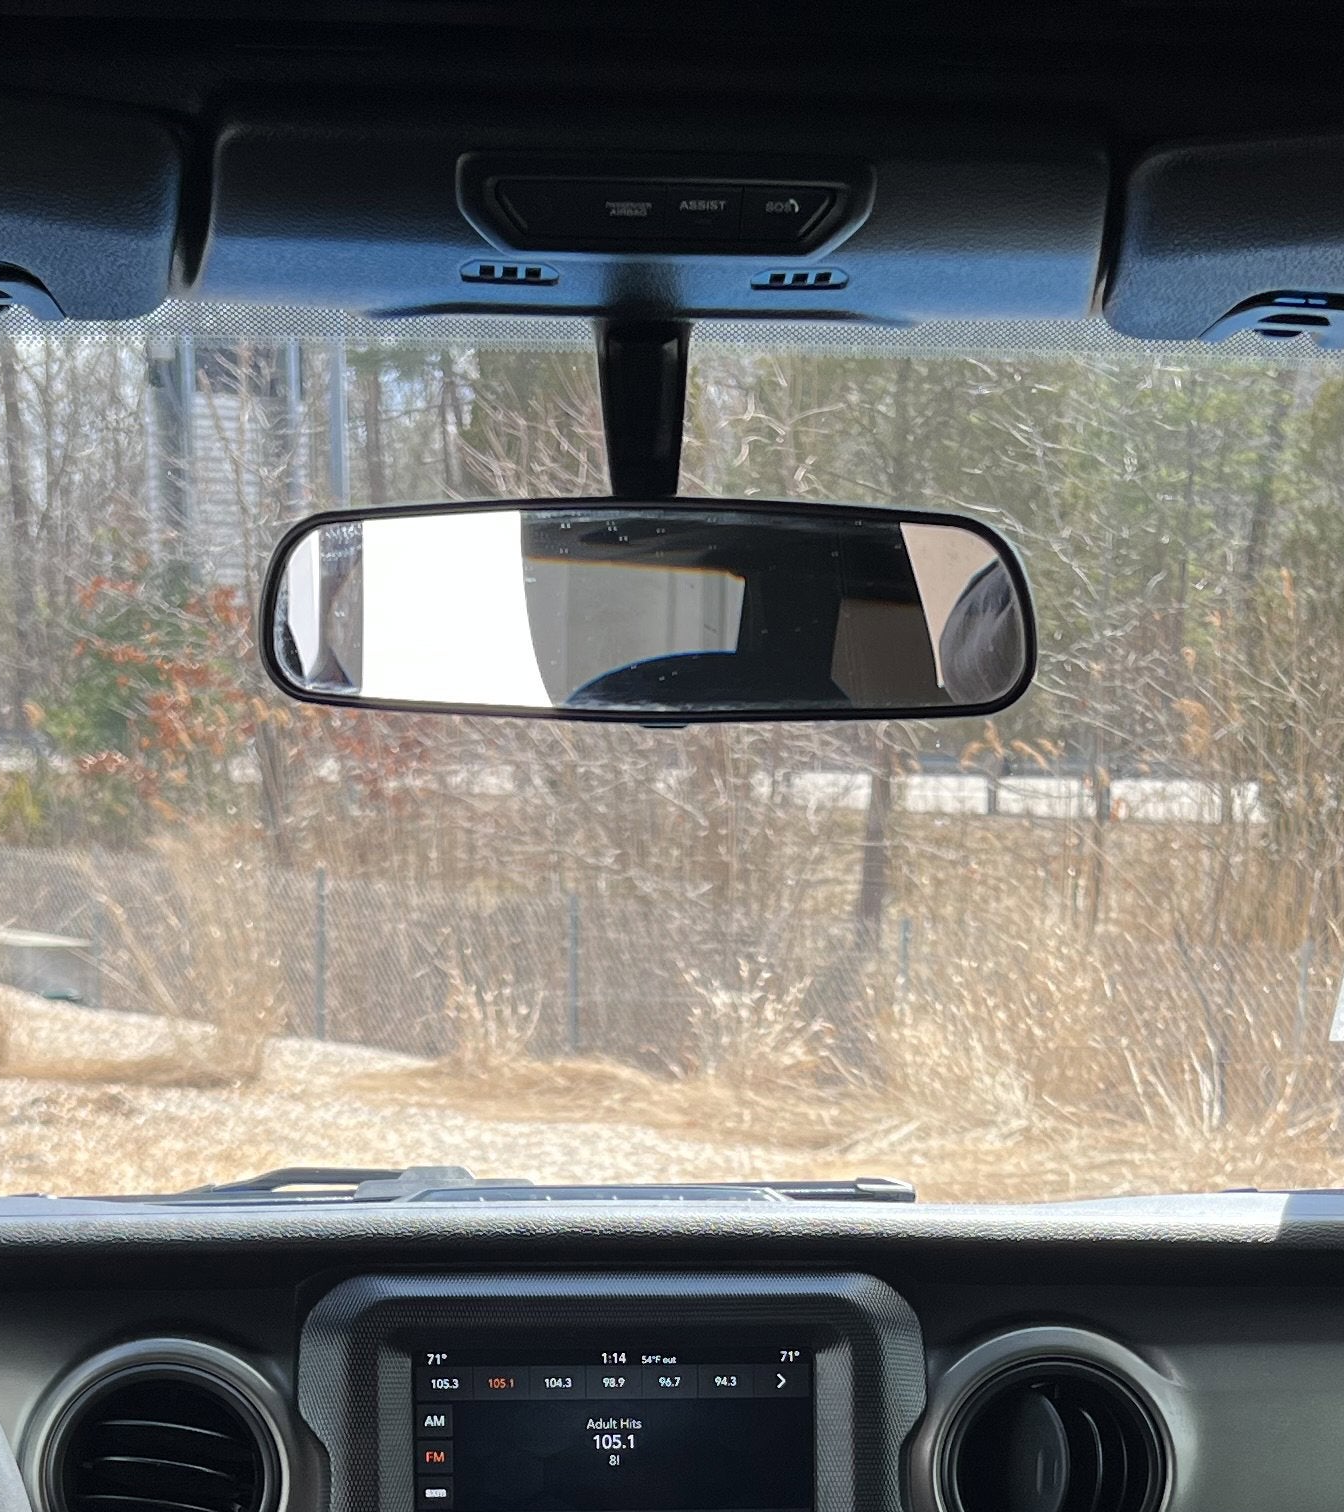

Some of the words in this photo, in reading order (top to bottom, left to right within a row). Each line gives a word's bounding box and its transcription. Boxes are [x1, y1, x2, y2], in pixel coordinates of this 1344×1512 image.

[680, 200, 726, 211] ASSIST
[426, 1353, 448, 1366] 71°
[601, 1352, 627, 1364] 1:14
[641, 1355, 661, 1364] 54°F
[663, 1356, 677, 1364] out
[780, 1350, 800, 1362] 71°
[431, 1378, 459, 1390] 105.3
[488, 1378, 515, 1389] 105.1
[544, 1378, 573, 1388] 104.3
[658, 1377, 681, 1387] 96.7
[714, 1376, 737, 1387] 94.3
[424, 1415, 445, 1427] AM
[586, 1417, 617, 1430] Adult
[620, 1417, 642, 1429] Hits
[593, 1434, 635, 1449] 105.1
[425, 1451, 445, 1463] FM
